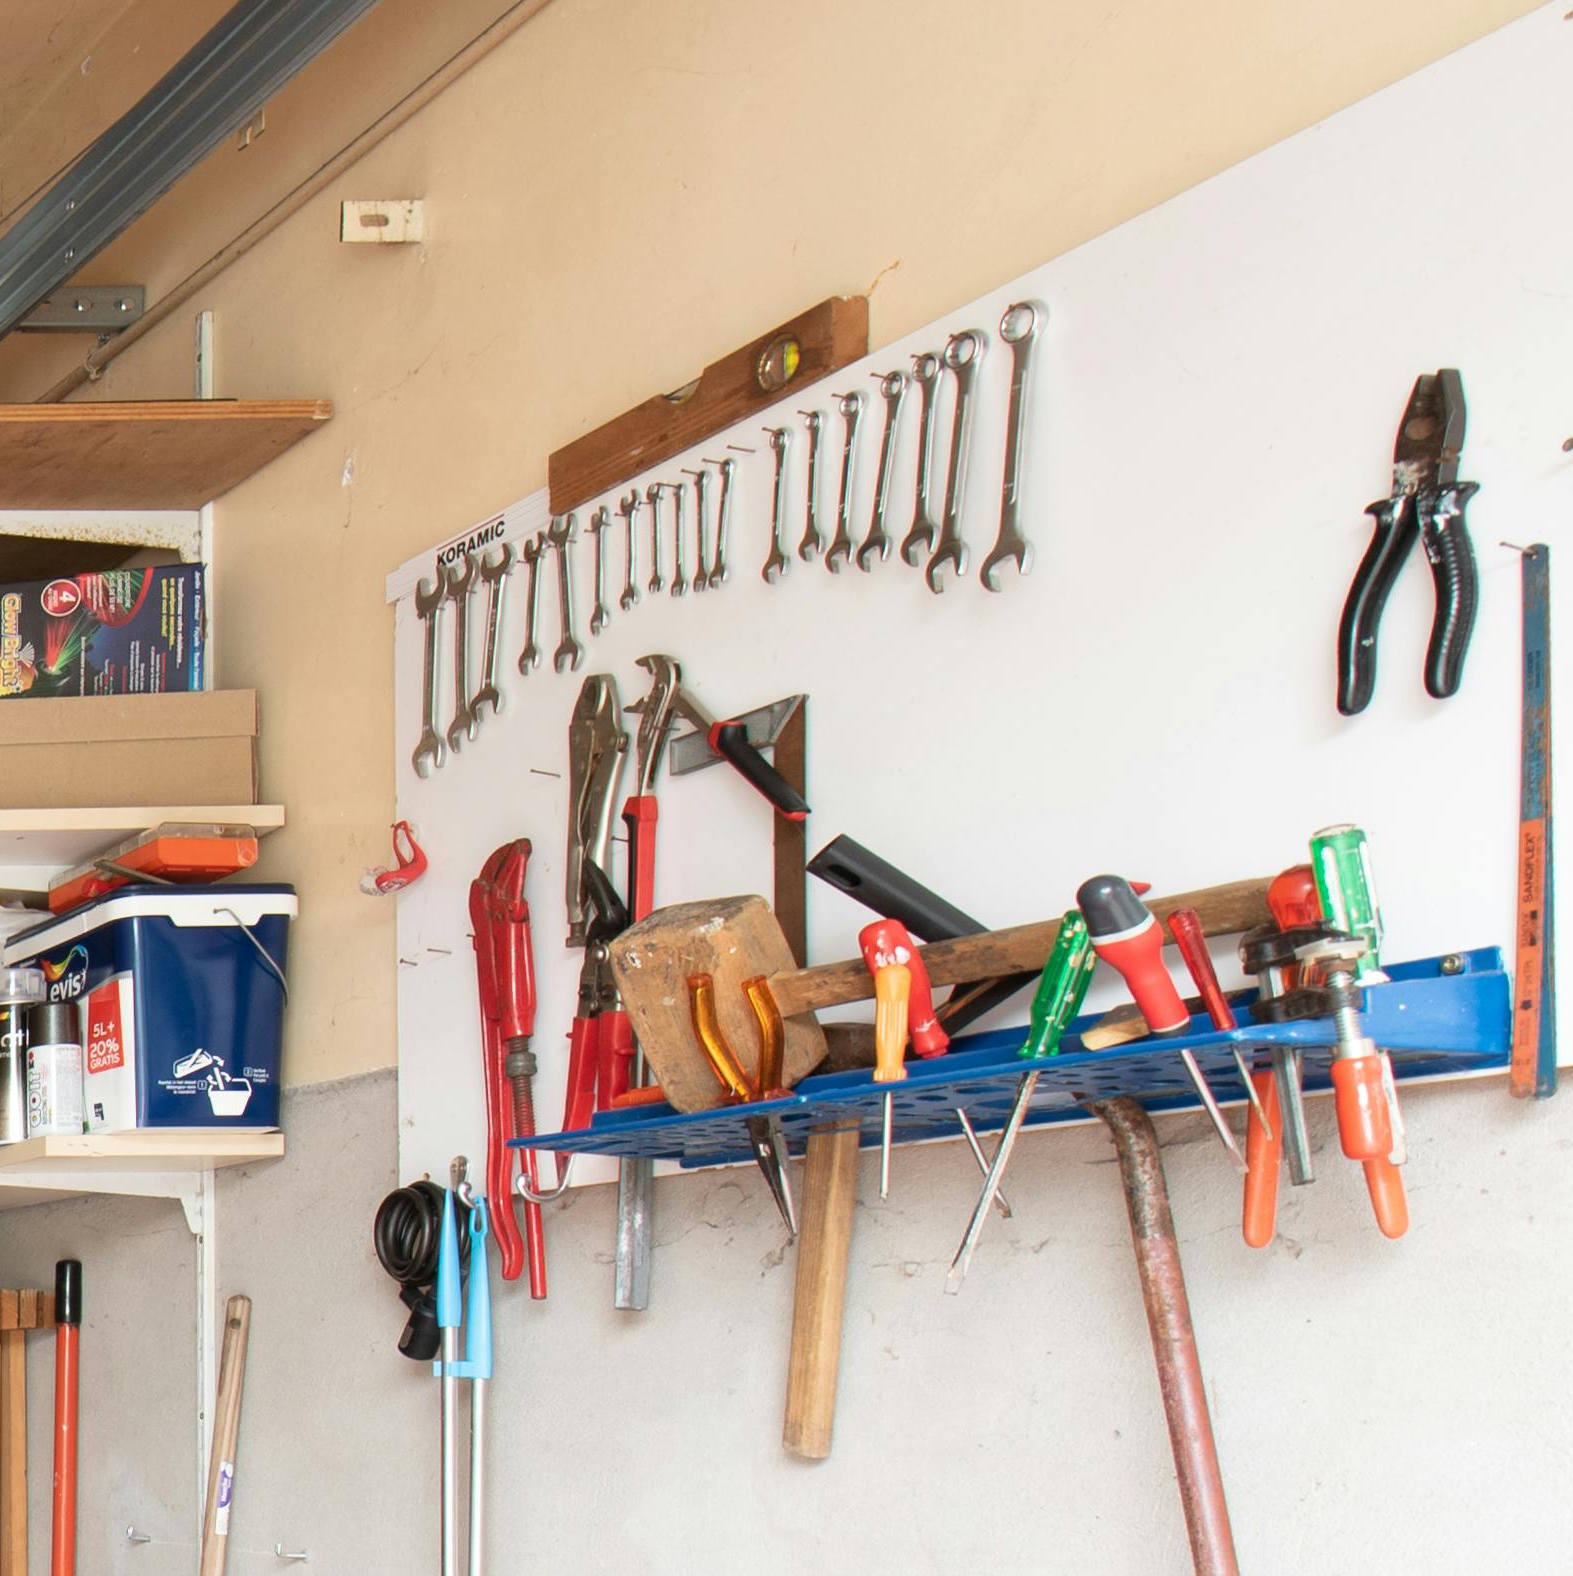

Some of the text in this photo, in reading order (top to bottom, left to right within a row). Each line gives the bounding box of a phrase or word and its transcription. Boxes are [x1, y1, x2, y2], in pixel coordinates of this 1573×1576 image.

[437, 520, 505, 566] KORAMIC
[59, 590, 76, 603] 4
[0, 593, 22, 687] Glow Bright
[1522, 834, 1535, 904] SANDFLEX
[49, 971, 82, 1003] evis
[90, 1039, 119, 1060] 20%
[90, 1053, 121, 1070] GRATIS
